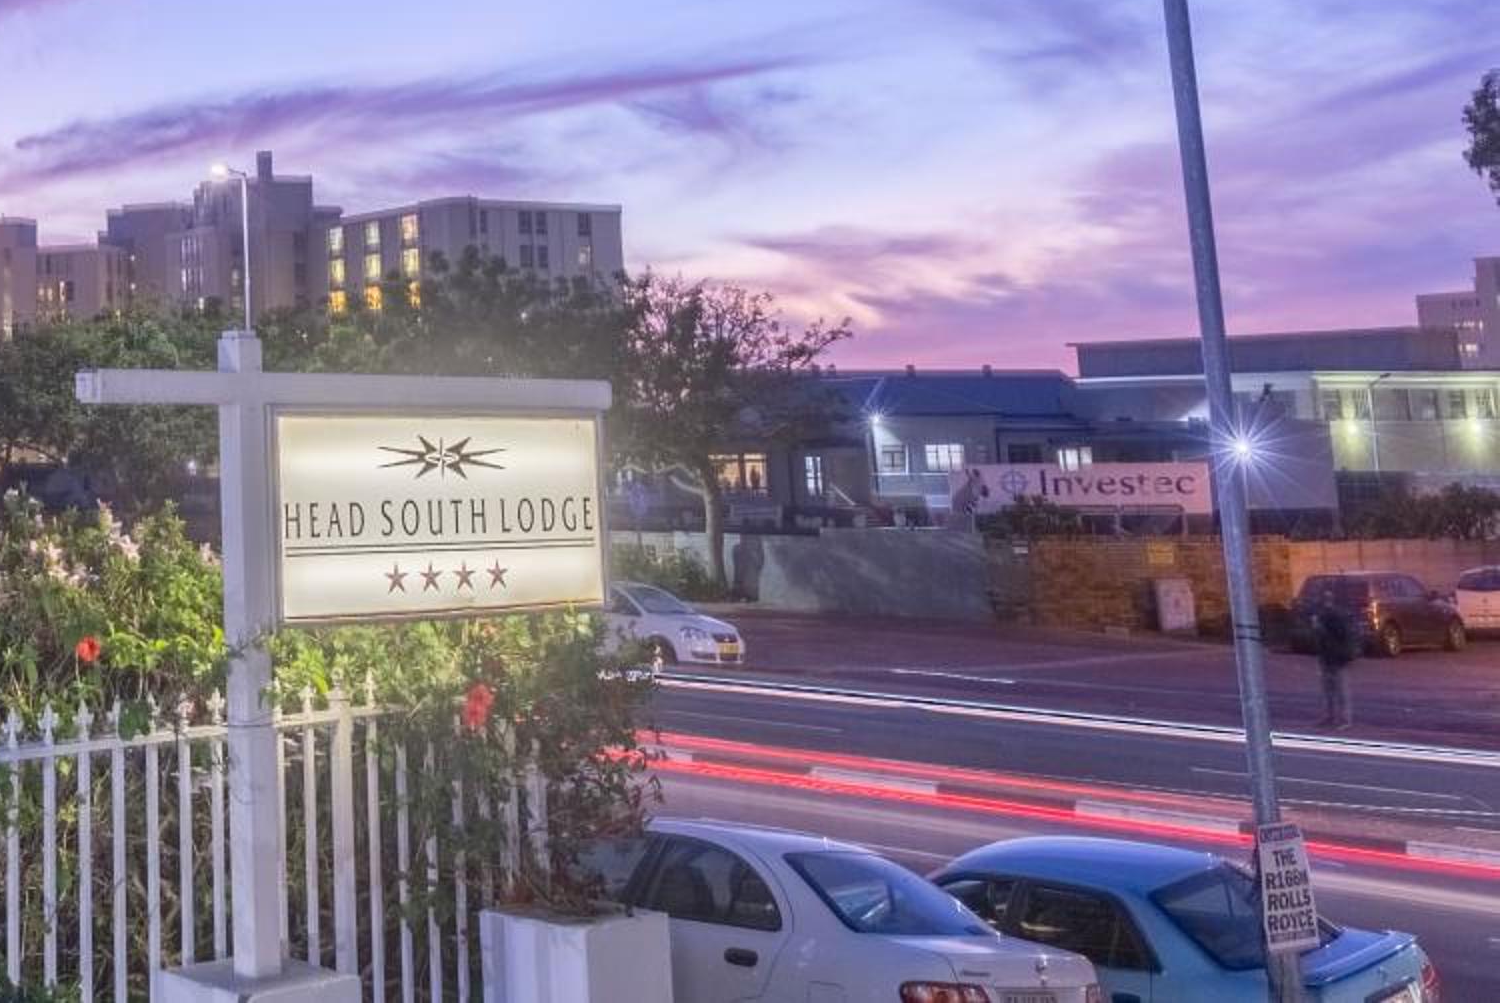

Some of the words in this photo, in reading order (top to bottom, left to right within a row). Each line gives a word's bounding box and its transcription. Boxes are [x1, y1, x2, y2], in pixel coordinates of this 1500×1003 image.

[1040, 469, 1196, 496] Investec
[284, 502, 365, 538] HEAD
[381, 499, 487, 536] SOUTH
[499, 497, 594, 533] LODGE
[1272, 848, 1297, 866] THE
[1267, 889, 1311, 911] ROLLS
[1268, 909, 1314, 931] ROYCE
